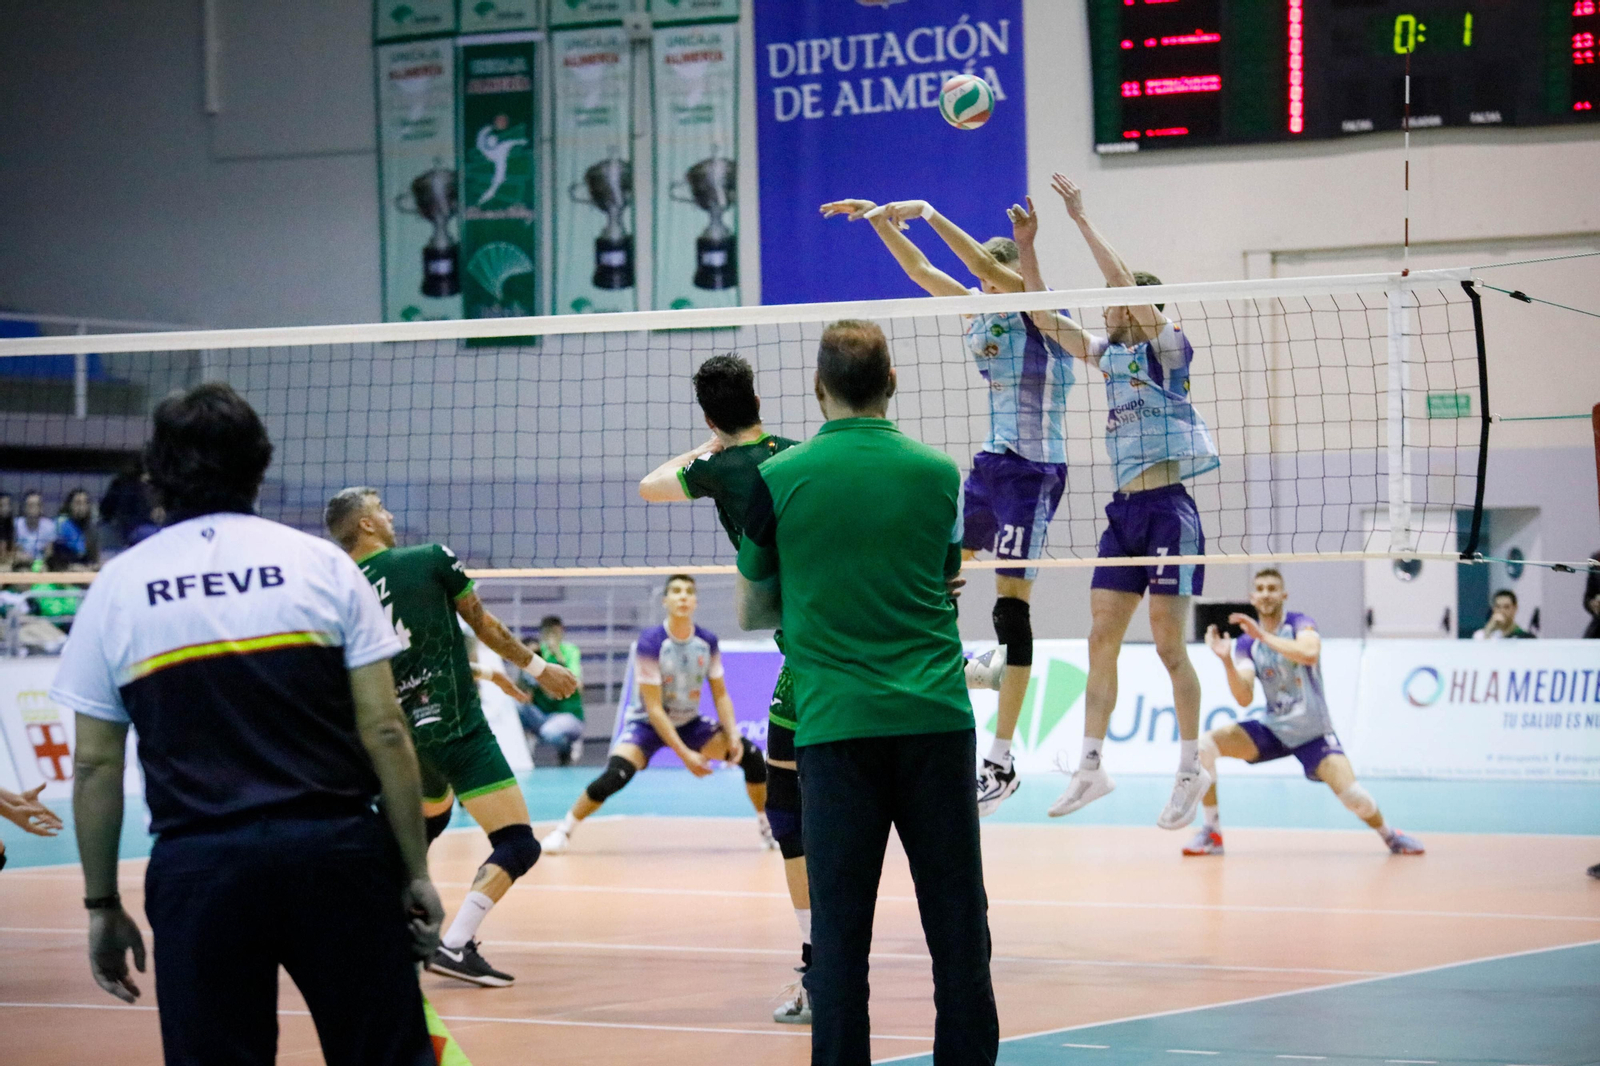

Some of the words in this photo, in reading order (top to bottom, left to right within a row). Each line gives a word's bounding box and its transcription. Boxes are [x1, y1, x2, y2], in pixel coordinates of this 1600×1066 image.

[767, 14, 1010, 78] DIPUTACIÓN
[773, 83, 824, 122] DE
[999, 524, 1025, 557] 21
[1156, 547, 1168, 575] 7
[146, 566, 285, 606] RFEVB
[1449, 669, 1500, 703] HLA
[1503, 711, 1518, 729] TU
[1521, 711, 1563, 729] SALUD
[1566, 711, 1582, 729] ES
